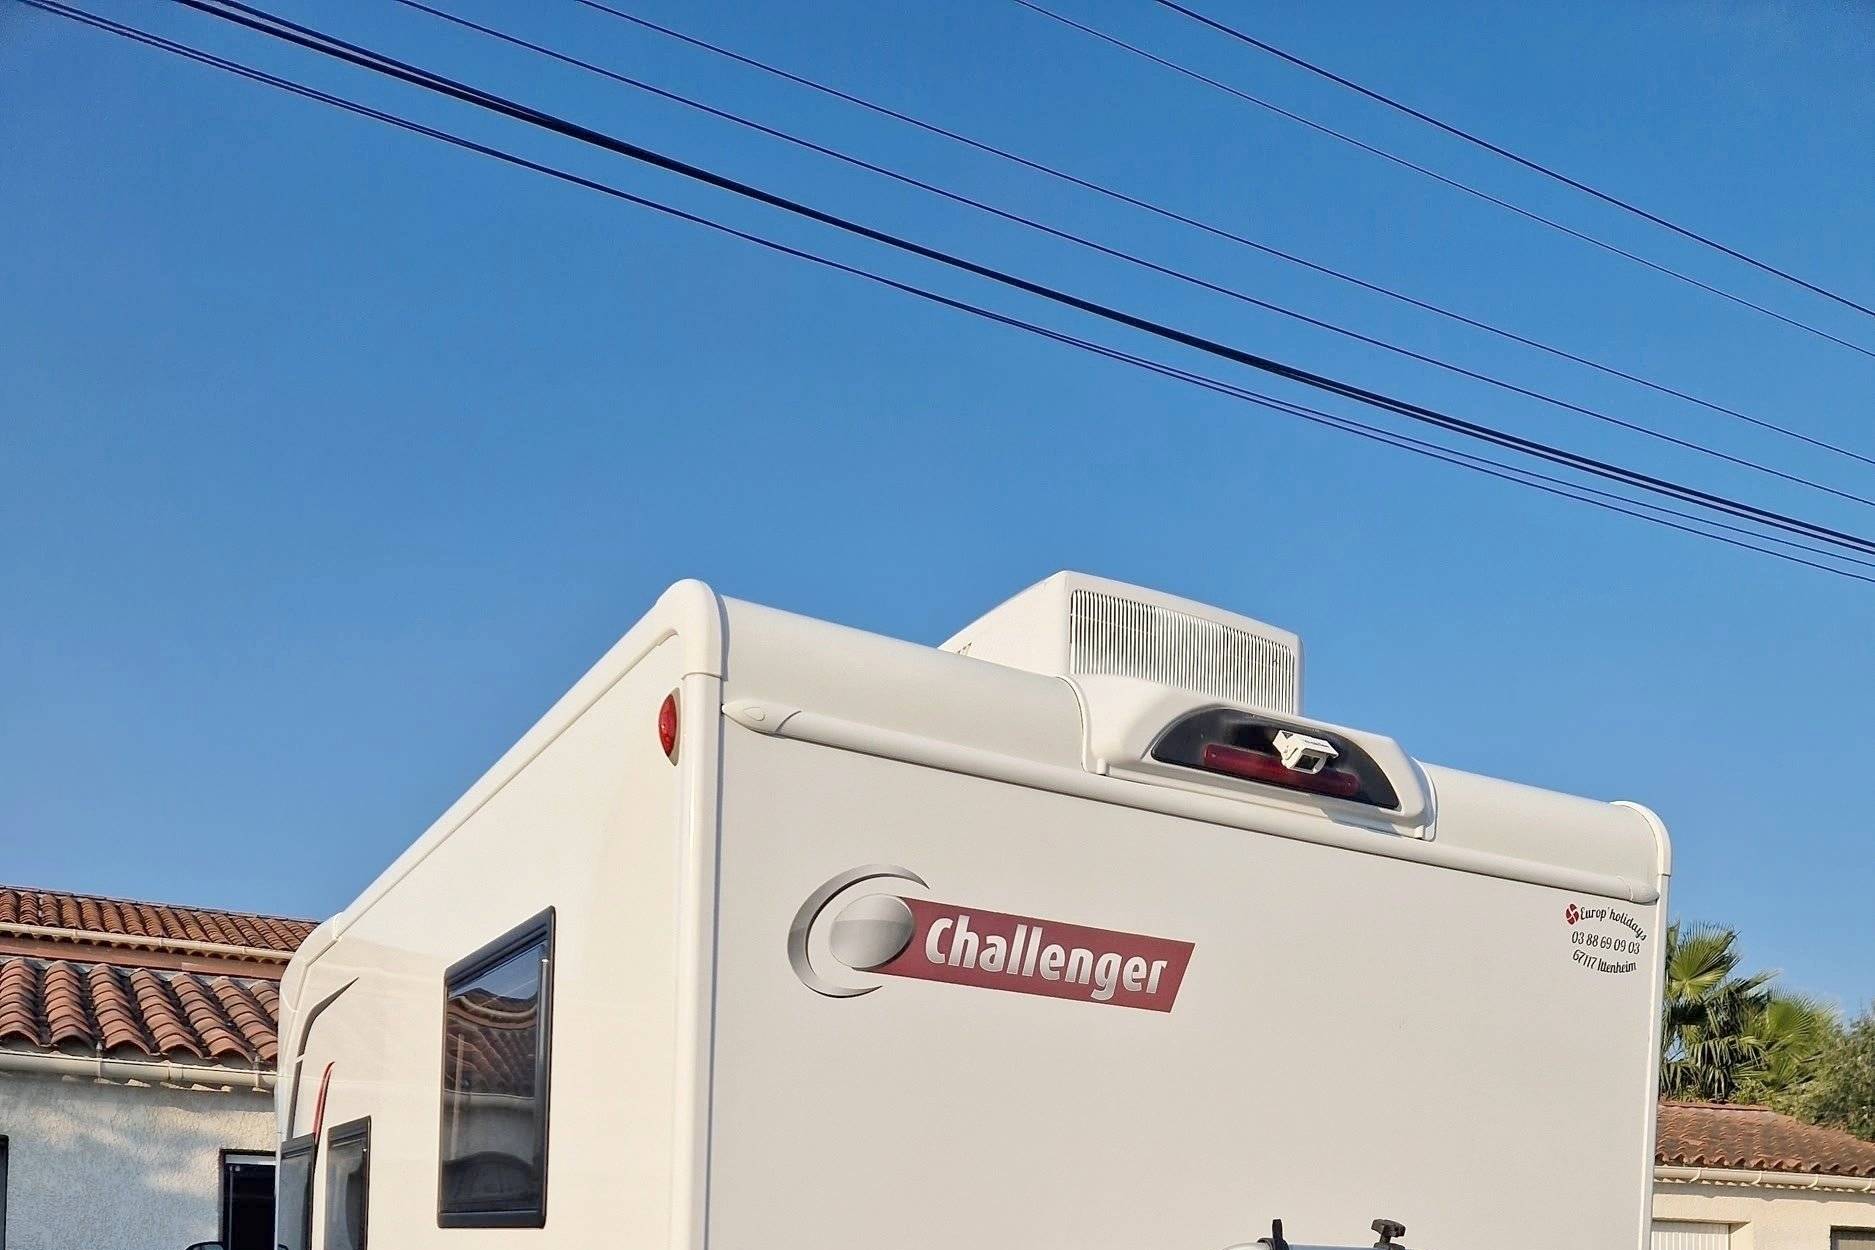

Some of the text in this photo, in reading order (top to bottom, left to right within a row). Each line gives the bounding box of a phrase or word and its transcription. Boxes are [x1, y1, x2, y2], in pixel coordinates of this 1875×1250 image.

[1572, 931, 1640, 954] 03 88 69 09 03
[925, 914, 1168, 1000] Challenger
[1572, 949, 1597, 969] 67117
